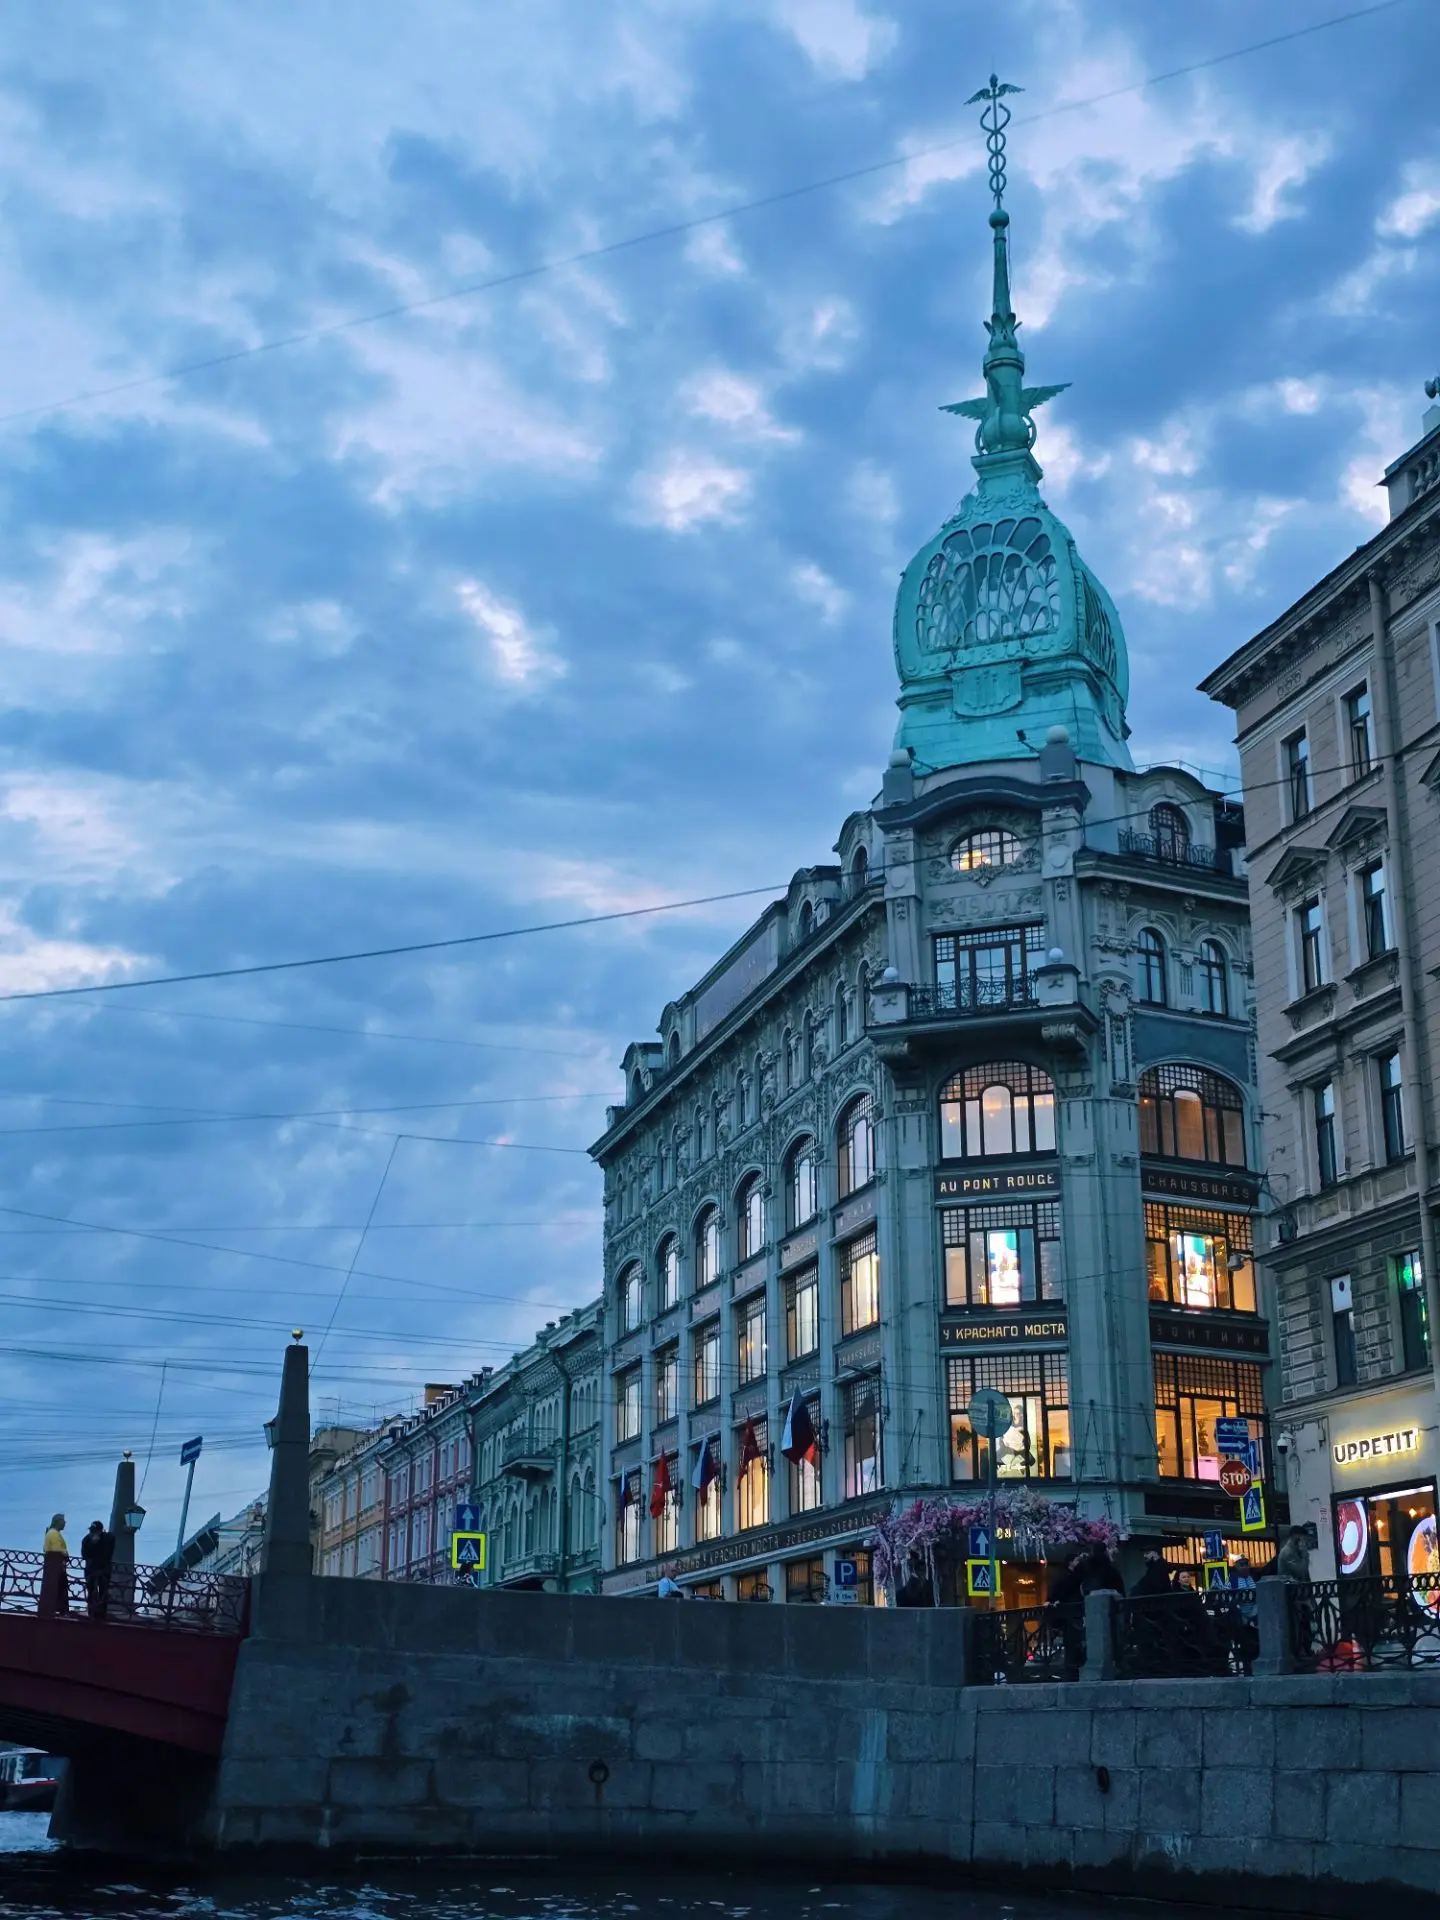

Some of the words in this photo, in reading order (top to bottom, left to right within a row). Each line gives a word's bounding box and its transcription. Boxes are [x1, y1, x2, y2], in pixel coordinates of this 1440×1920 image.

[940, 1180, 957, 1193] AU
[963, 1177, 1000, 1191] PONT
[1007, 1173, 1055, 1188] ROUGE
[1148, 1175, 1250, 1200] CHAUSSURES
[942, 1328, 950, 1341] У
[956, 1325, 1019, 1341] КРАСНАГО
[1024, 1322, 1066, 1336] МОСТА
[1155, 1323, 1261, 1347] ЗОНТИКИ
[1333, 1429, 1414, 1463] UPPETIT
[1222, 1472, 1250, 1486] STOP
[840, 1562, 854, 1583] P
